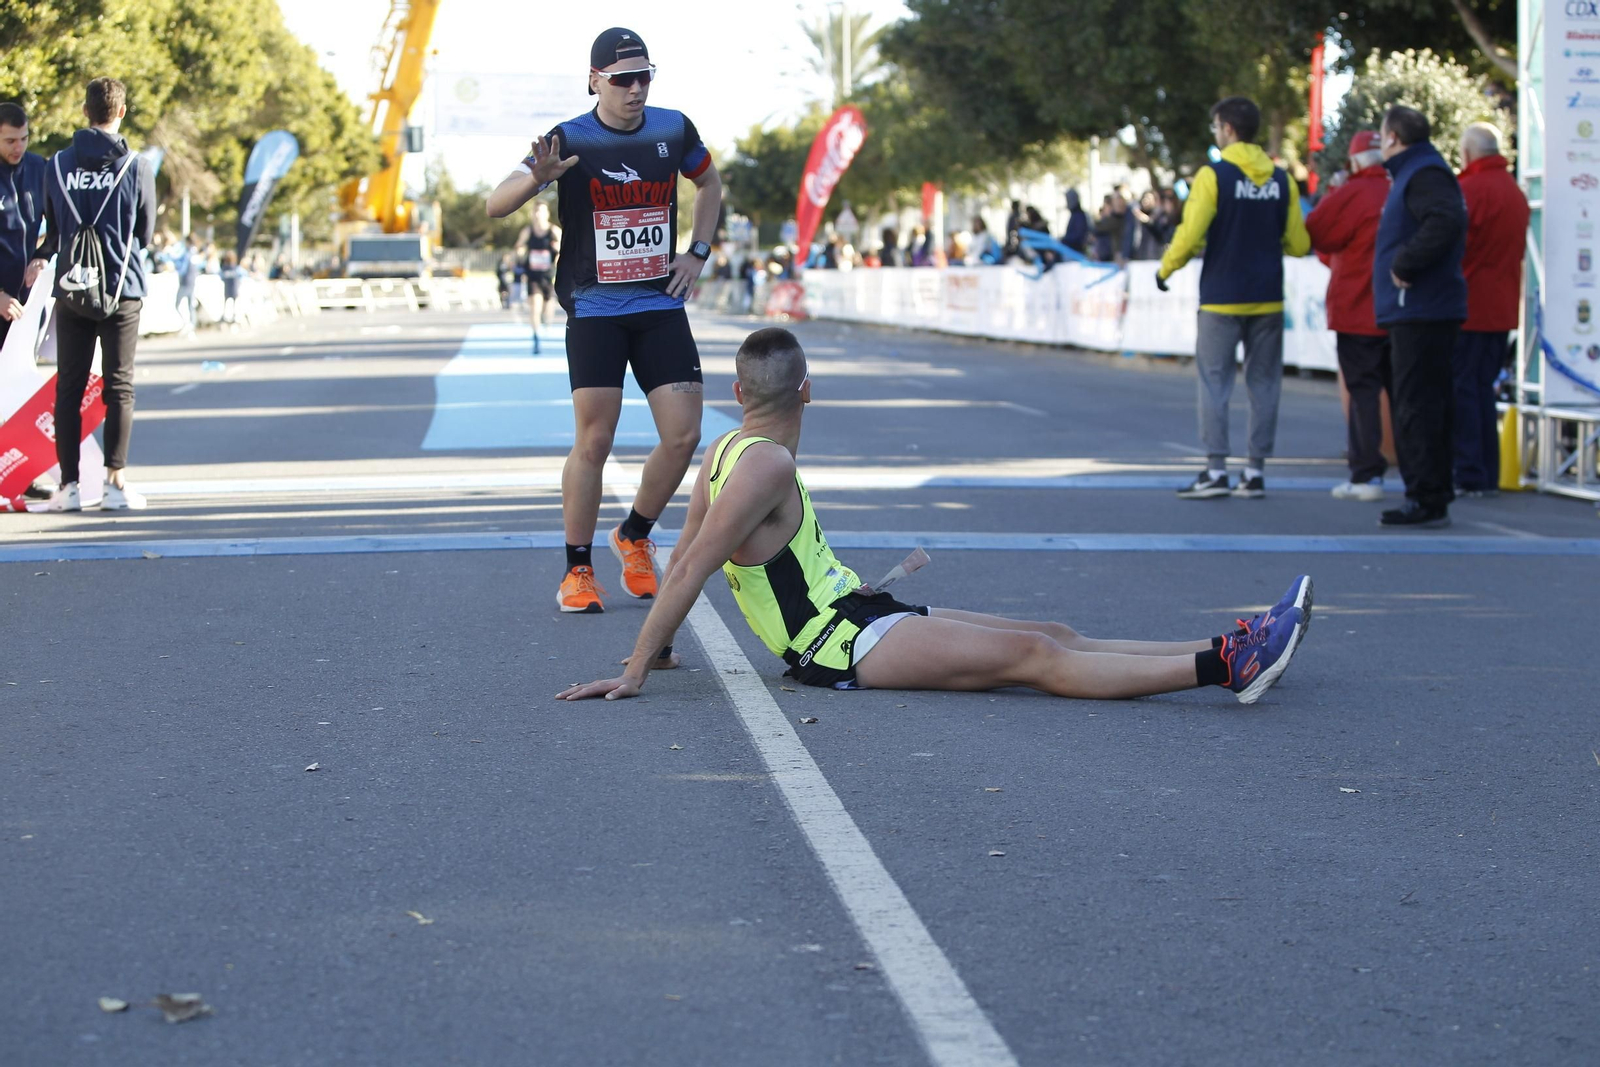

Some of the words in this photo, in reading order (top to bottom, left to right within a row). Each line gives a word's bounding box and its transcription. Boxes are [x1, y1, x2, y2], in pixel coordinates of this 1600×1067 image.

[66, 171, 115, 190] NEXA
[1235, 178, 1280, 199] NEXA
[606, 226, 663, 250] 5040
[618, 247, 654, 256] ELCABESSA
[811, 623, 836, 652] Kalenji
